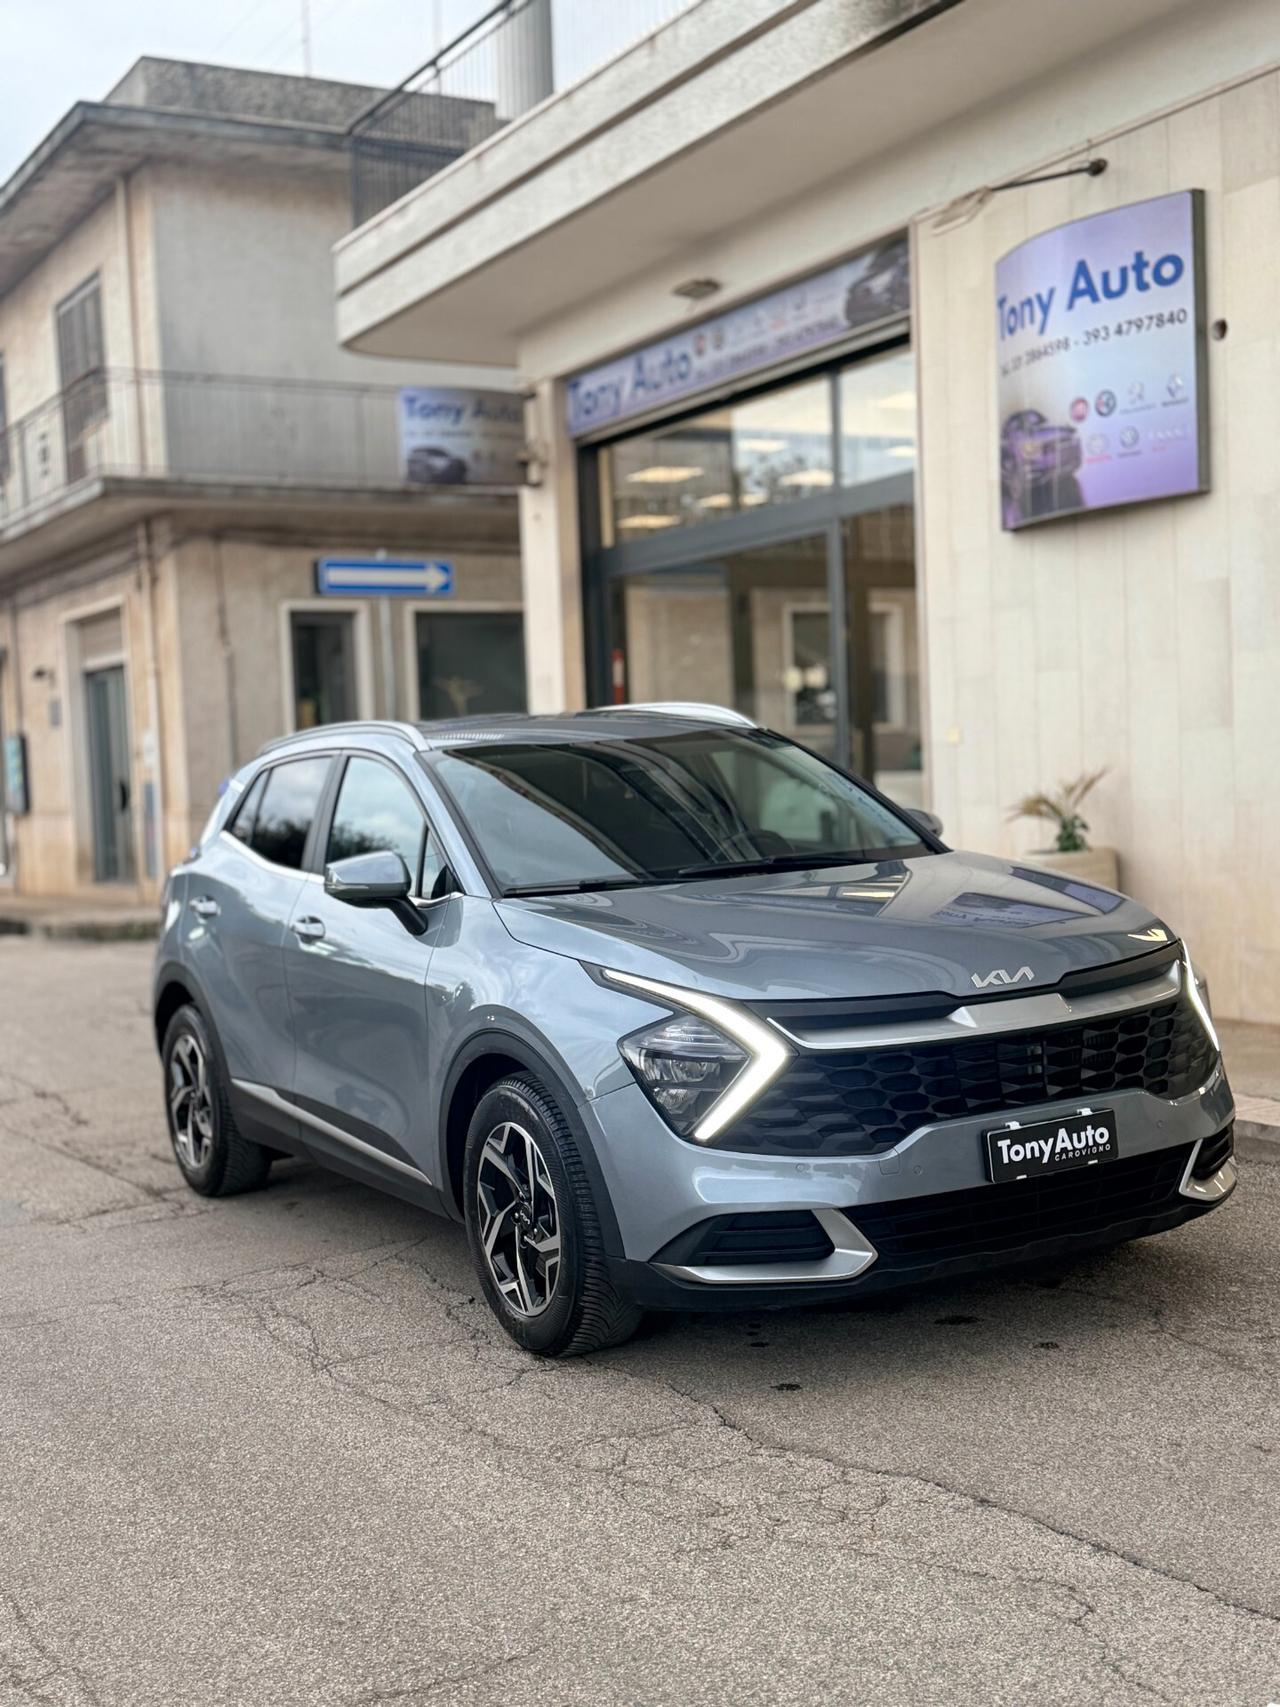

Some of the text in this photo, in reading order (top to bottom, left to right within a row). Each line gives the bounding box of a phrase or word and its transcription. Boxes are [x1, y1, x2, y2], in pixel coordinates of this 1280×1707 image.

[996, 250, 1185, 342] Tony Auto
[1114, 308, 1188, 337] 4797840
[630, 349, 691, 396] Auto
[404, 395, 464, 427] Tony
[971, 965, 1035, 989] KIA
[1054, 1143, 1111, 1162] CAROVIGNO
